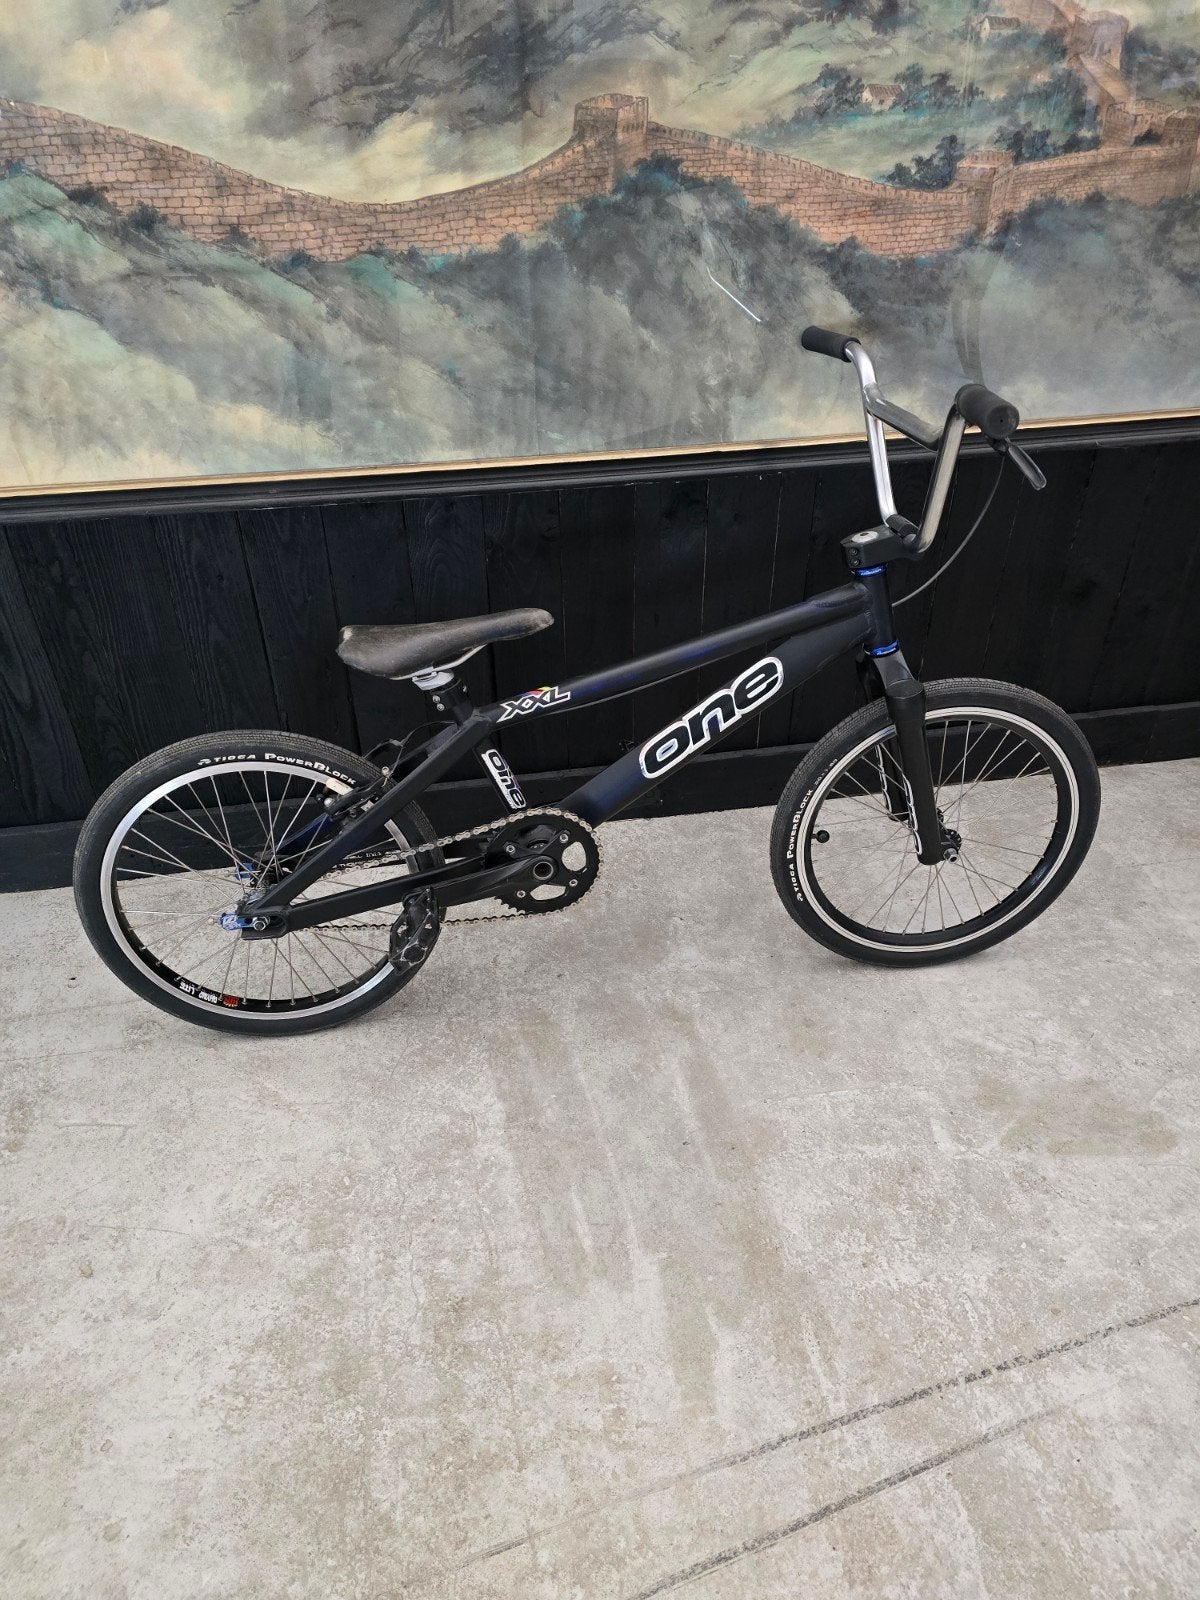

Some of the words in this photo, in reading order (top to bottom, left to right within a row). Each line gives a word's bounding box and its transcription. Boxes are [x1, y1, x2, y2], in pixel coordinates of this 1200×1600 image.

[496, 686, 571, 723] XXL
[639, 656, 784, 779] one
[213, 754, 257, 763] TIOGA
[264, 752, 356, 785] POWERBLOCK
[481, 748, 527, 810] one
